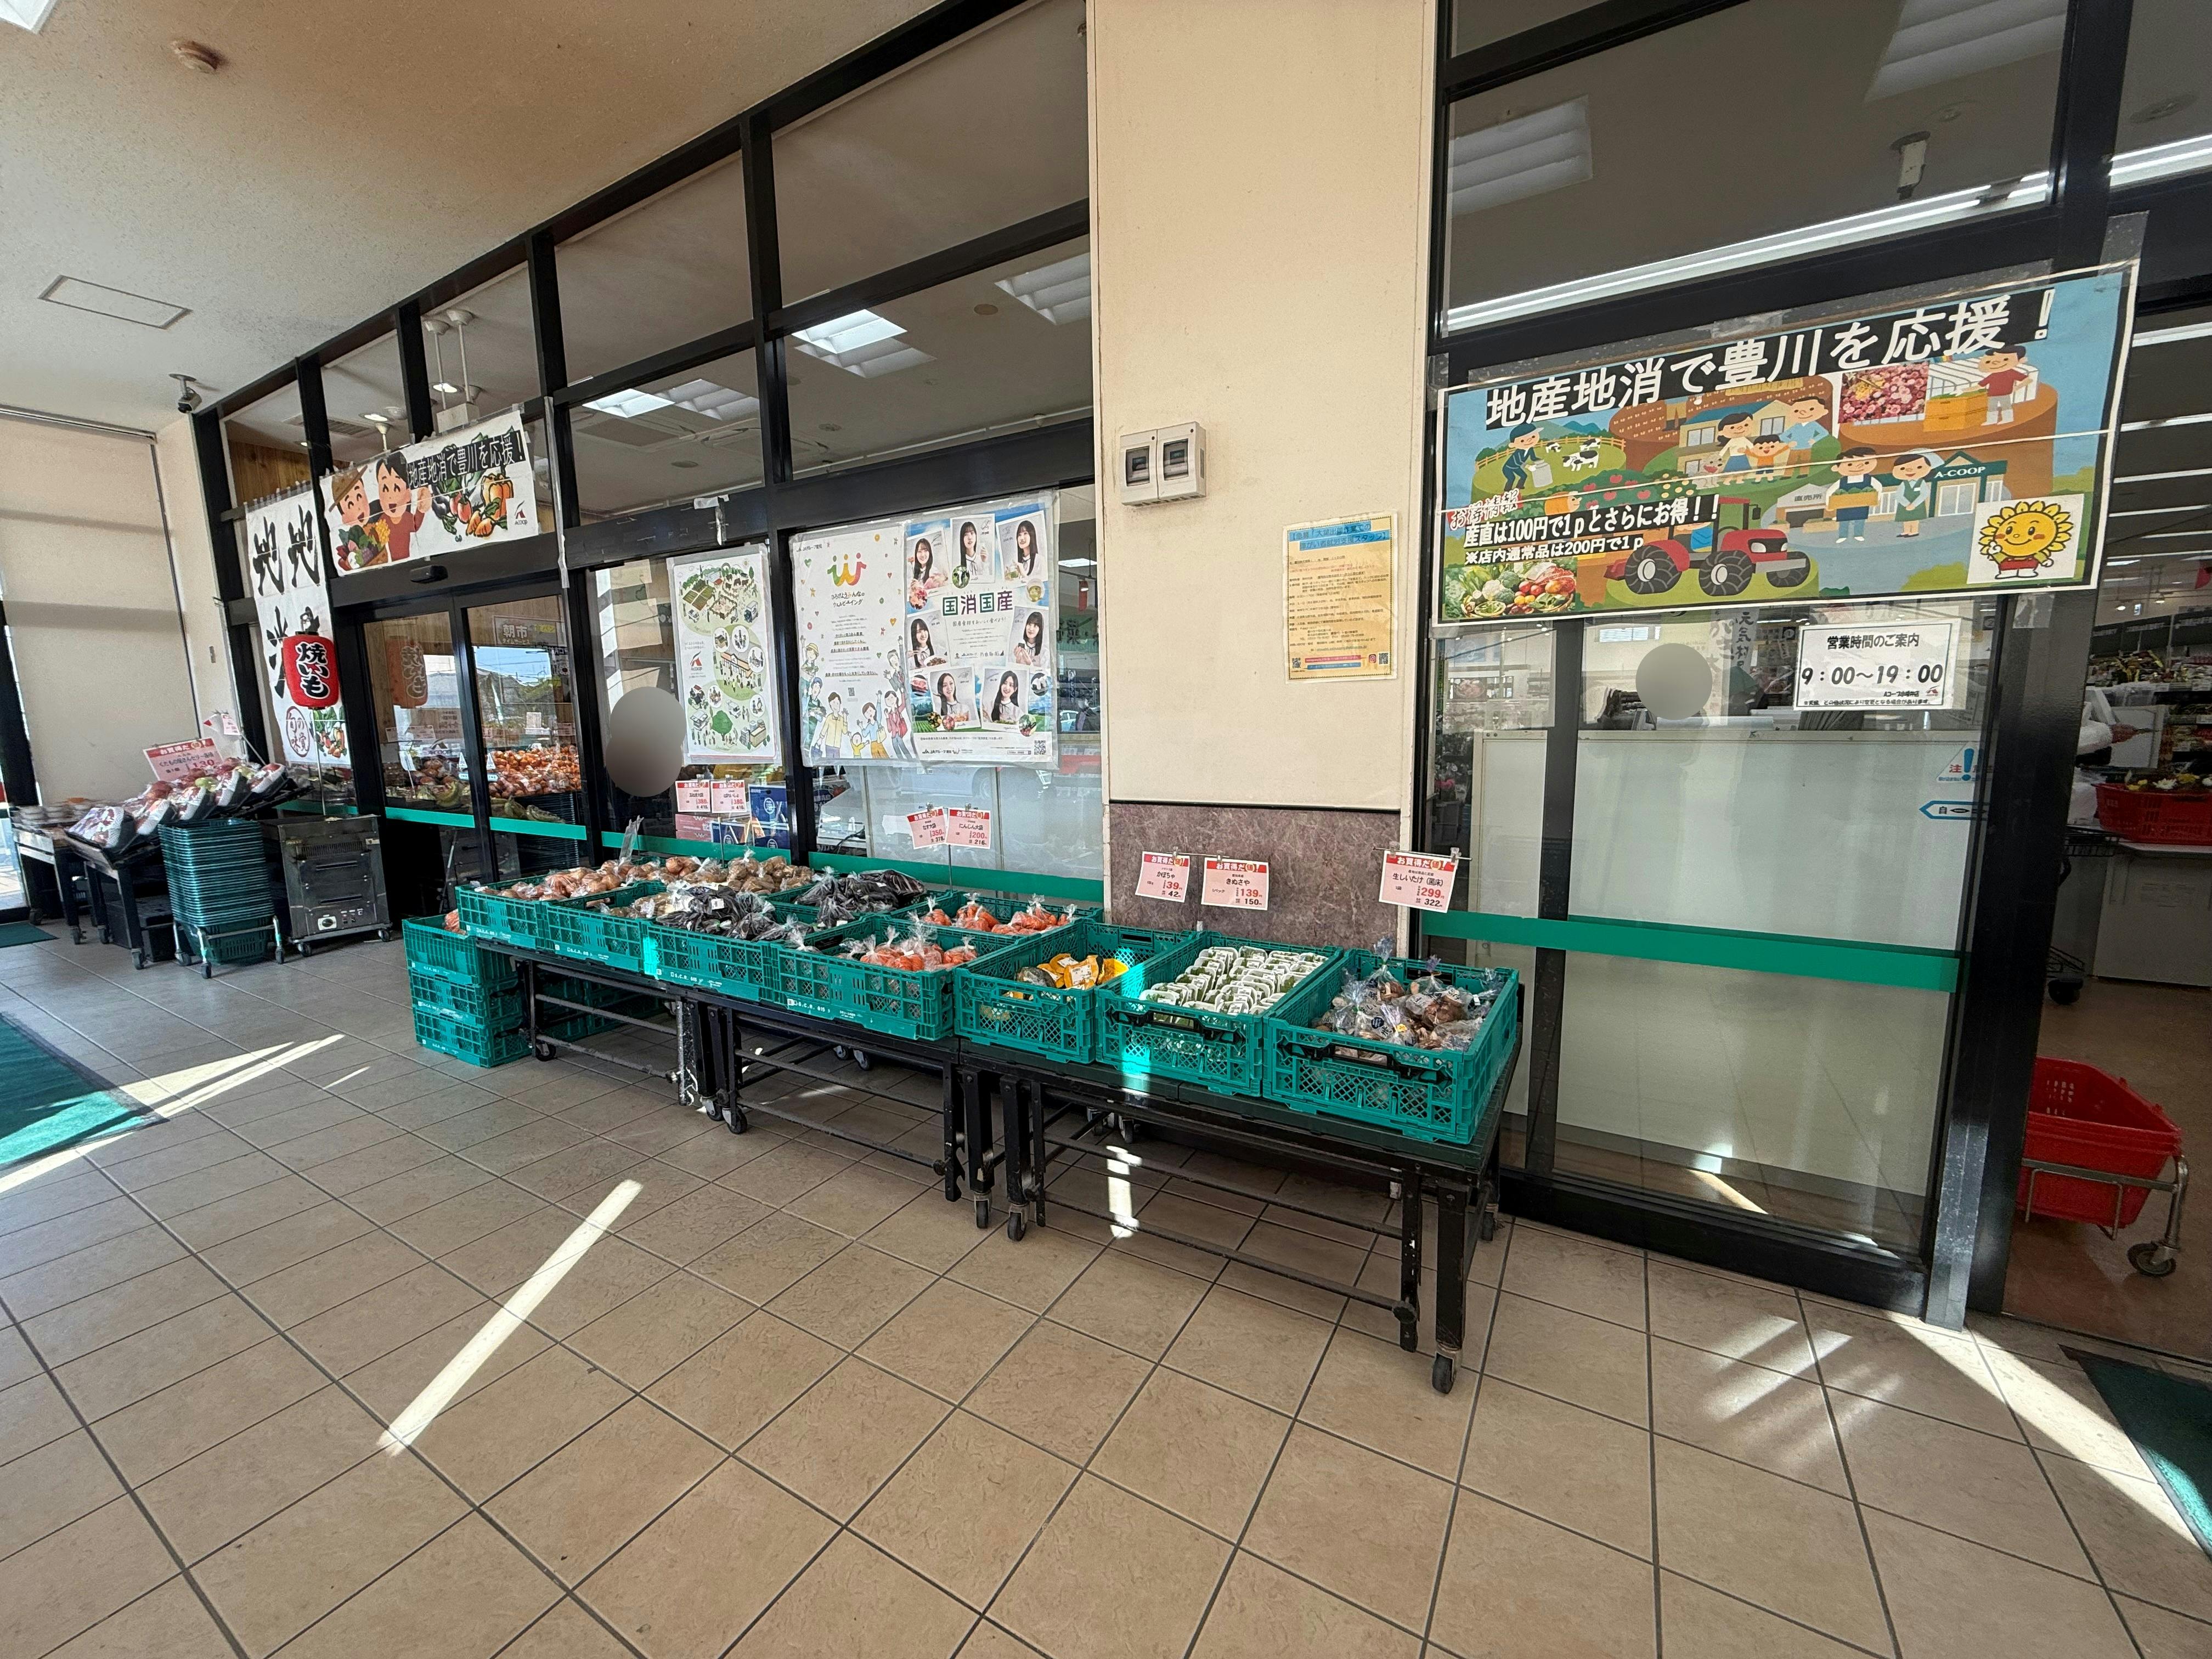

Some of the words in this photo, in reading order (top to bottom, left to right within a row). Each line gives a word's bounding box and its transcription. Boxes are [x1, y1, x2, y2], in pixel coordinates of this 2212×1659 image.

[1485, 289, 2055, 430] 地産地消で豊川を応援！
[408, 432, 523, 489] 地産地消で豊川を応援！
[1934, 466, 1986, 479] A-COOP
[943, 590, 1013, 617] 国消国産
[503, 624, 527, 639] 朝市
[1827, 633, 1920, 650] 営業時間のご案内
[295, 641, 331, 699] 焼いも
[1156, 871, 1176, 879] かぼちゃ
[1226, 878, 1250, 886] きぬさや
